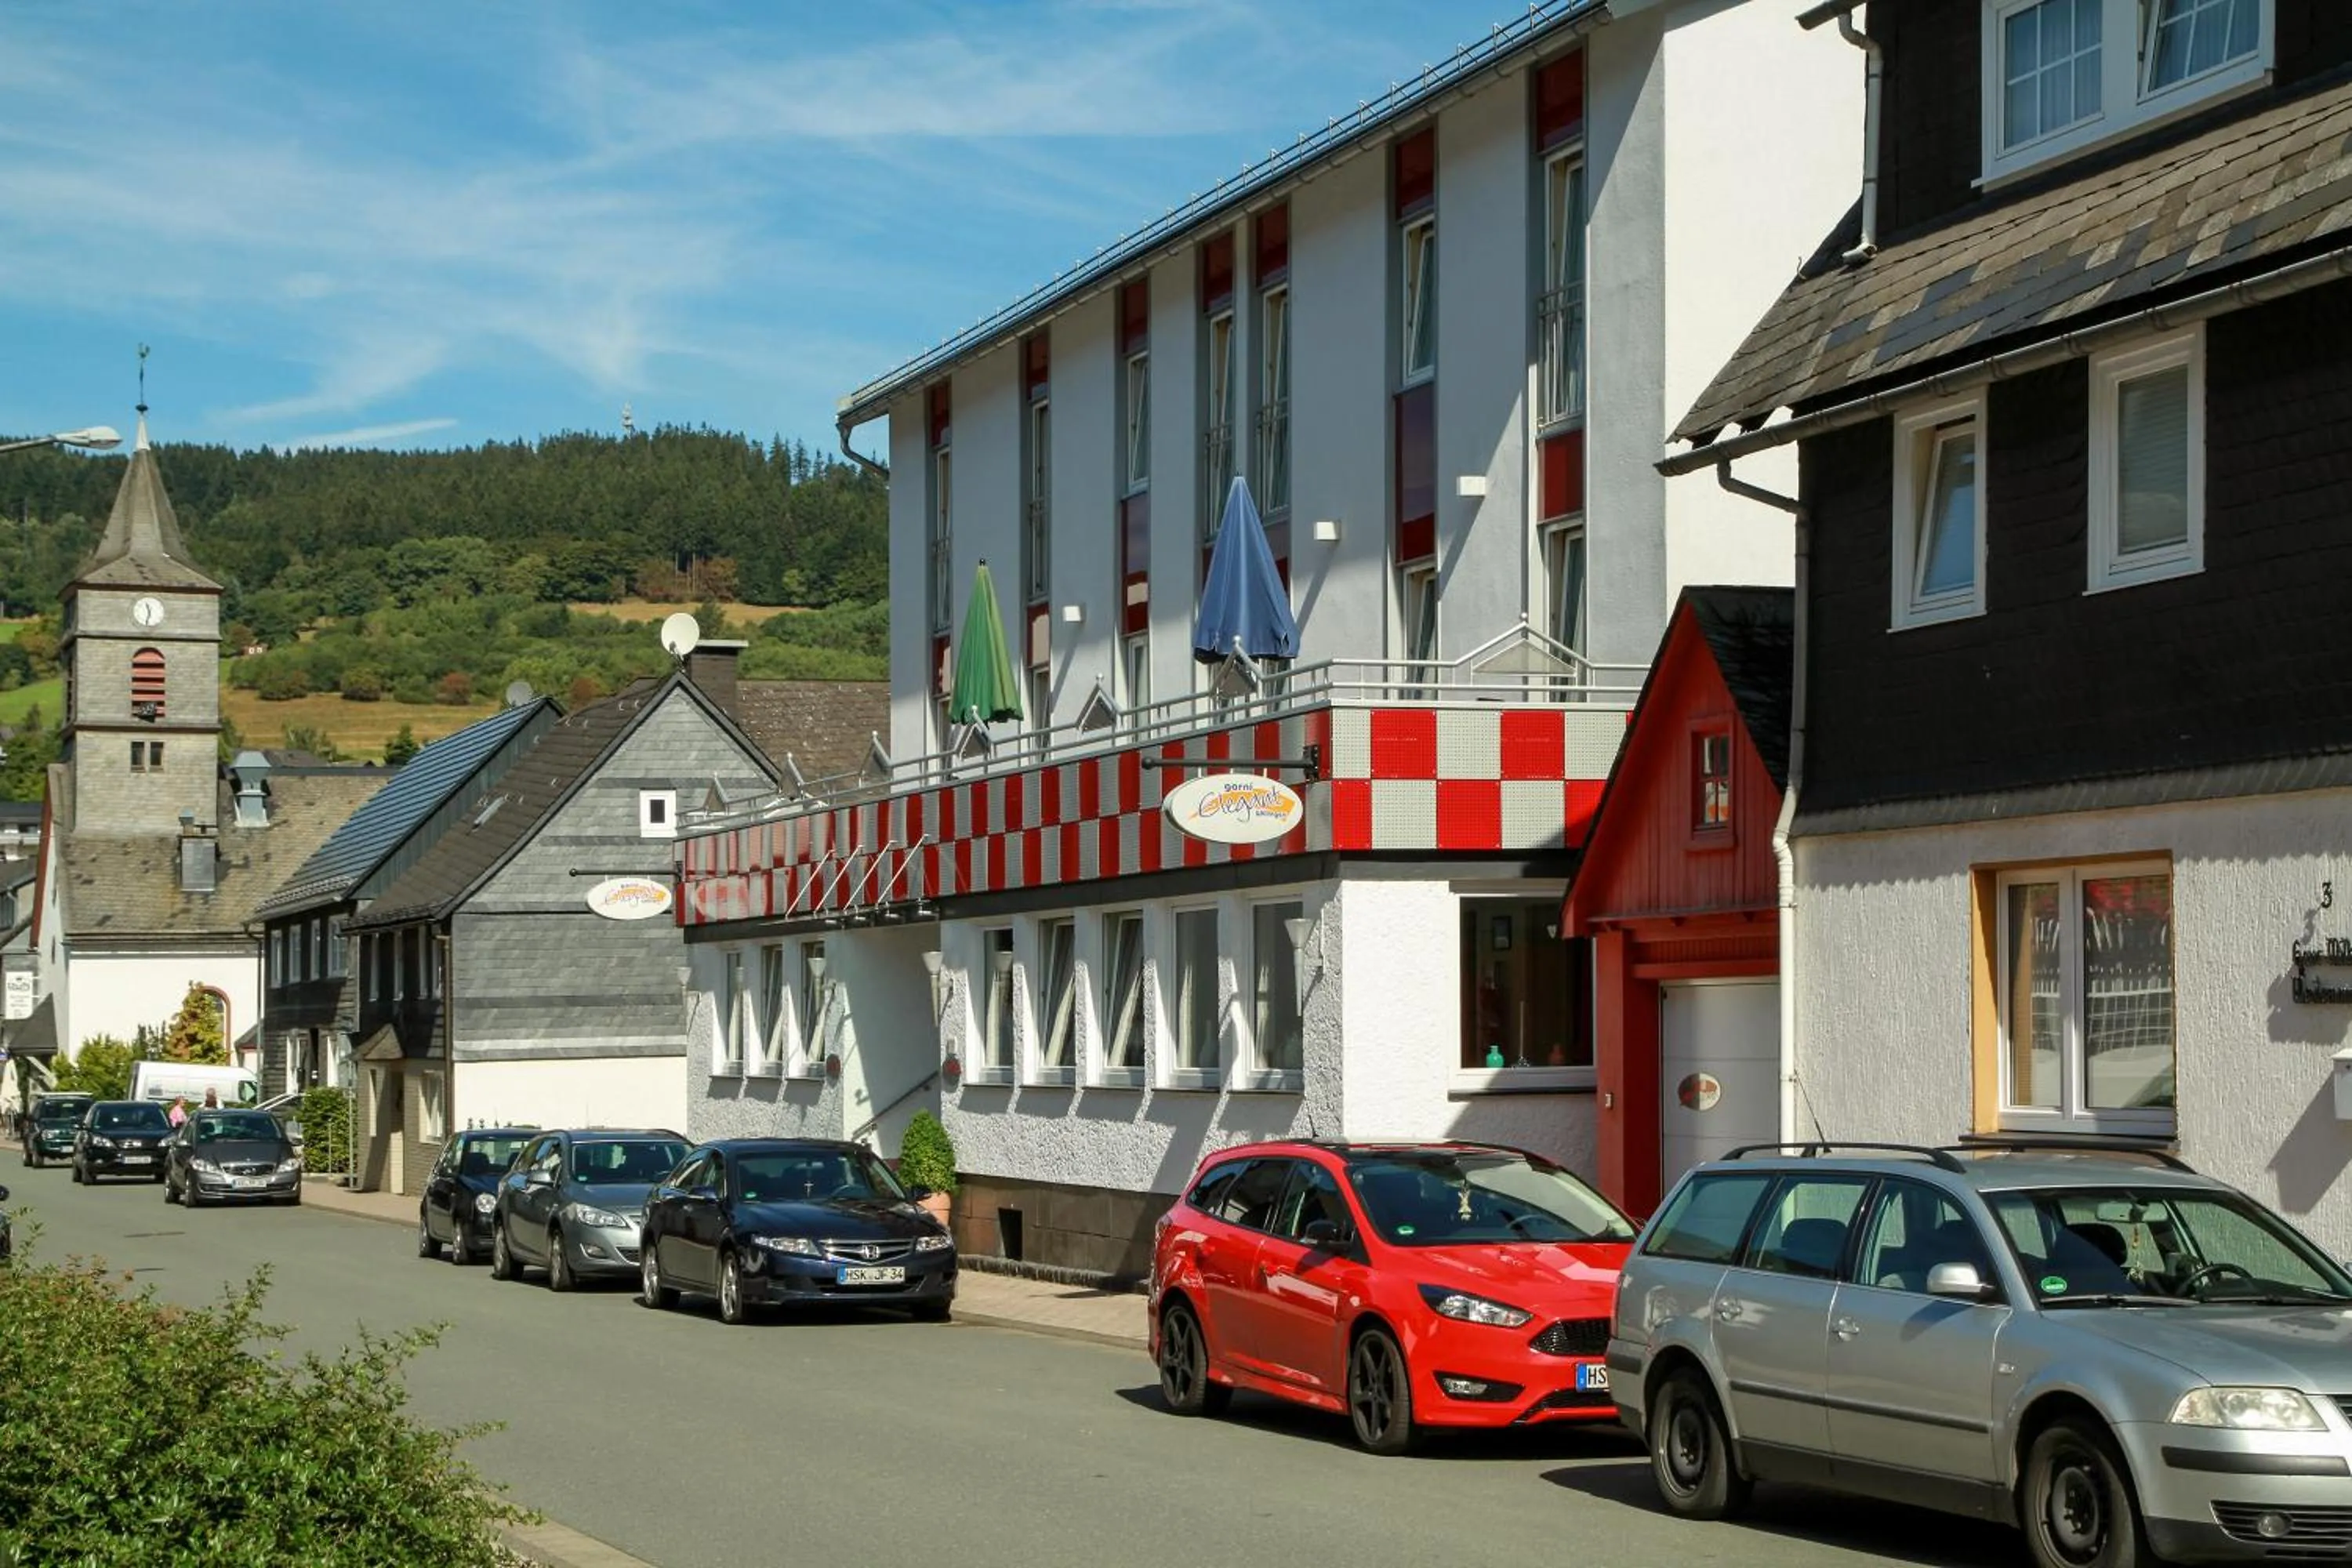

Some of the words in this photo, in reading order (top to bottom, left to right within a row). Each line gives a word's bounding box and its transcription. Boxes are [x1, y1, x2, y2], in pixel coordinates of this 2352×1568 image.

[1200, 786, 1280, 822] Elegant
[2321, 881, 2332, 909] 3
[847, 1269, 866, 1280] HSK
[890, 1268, 903, 1279] 34
